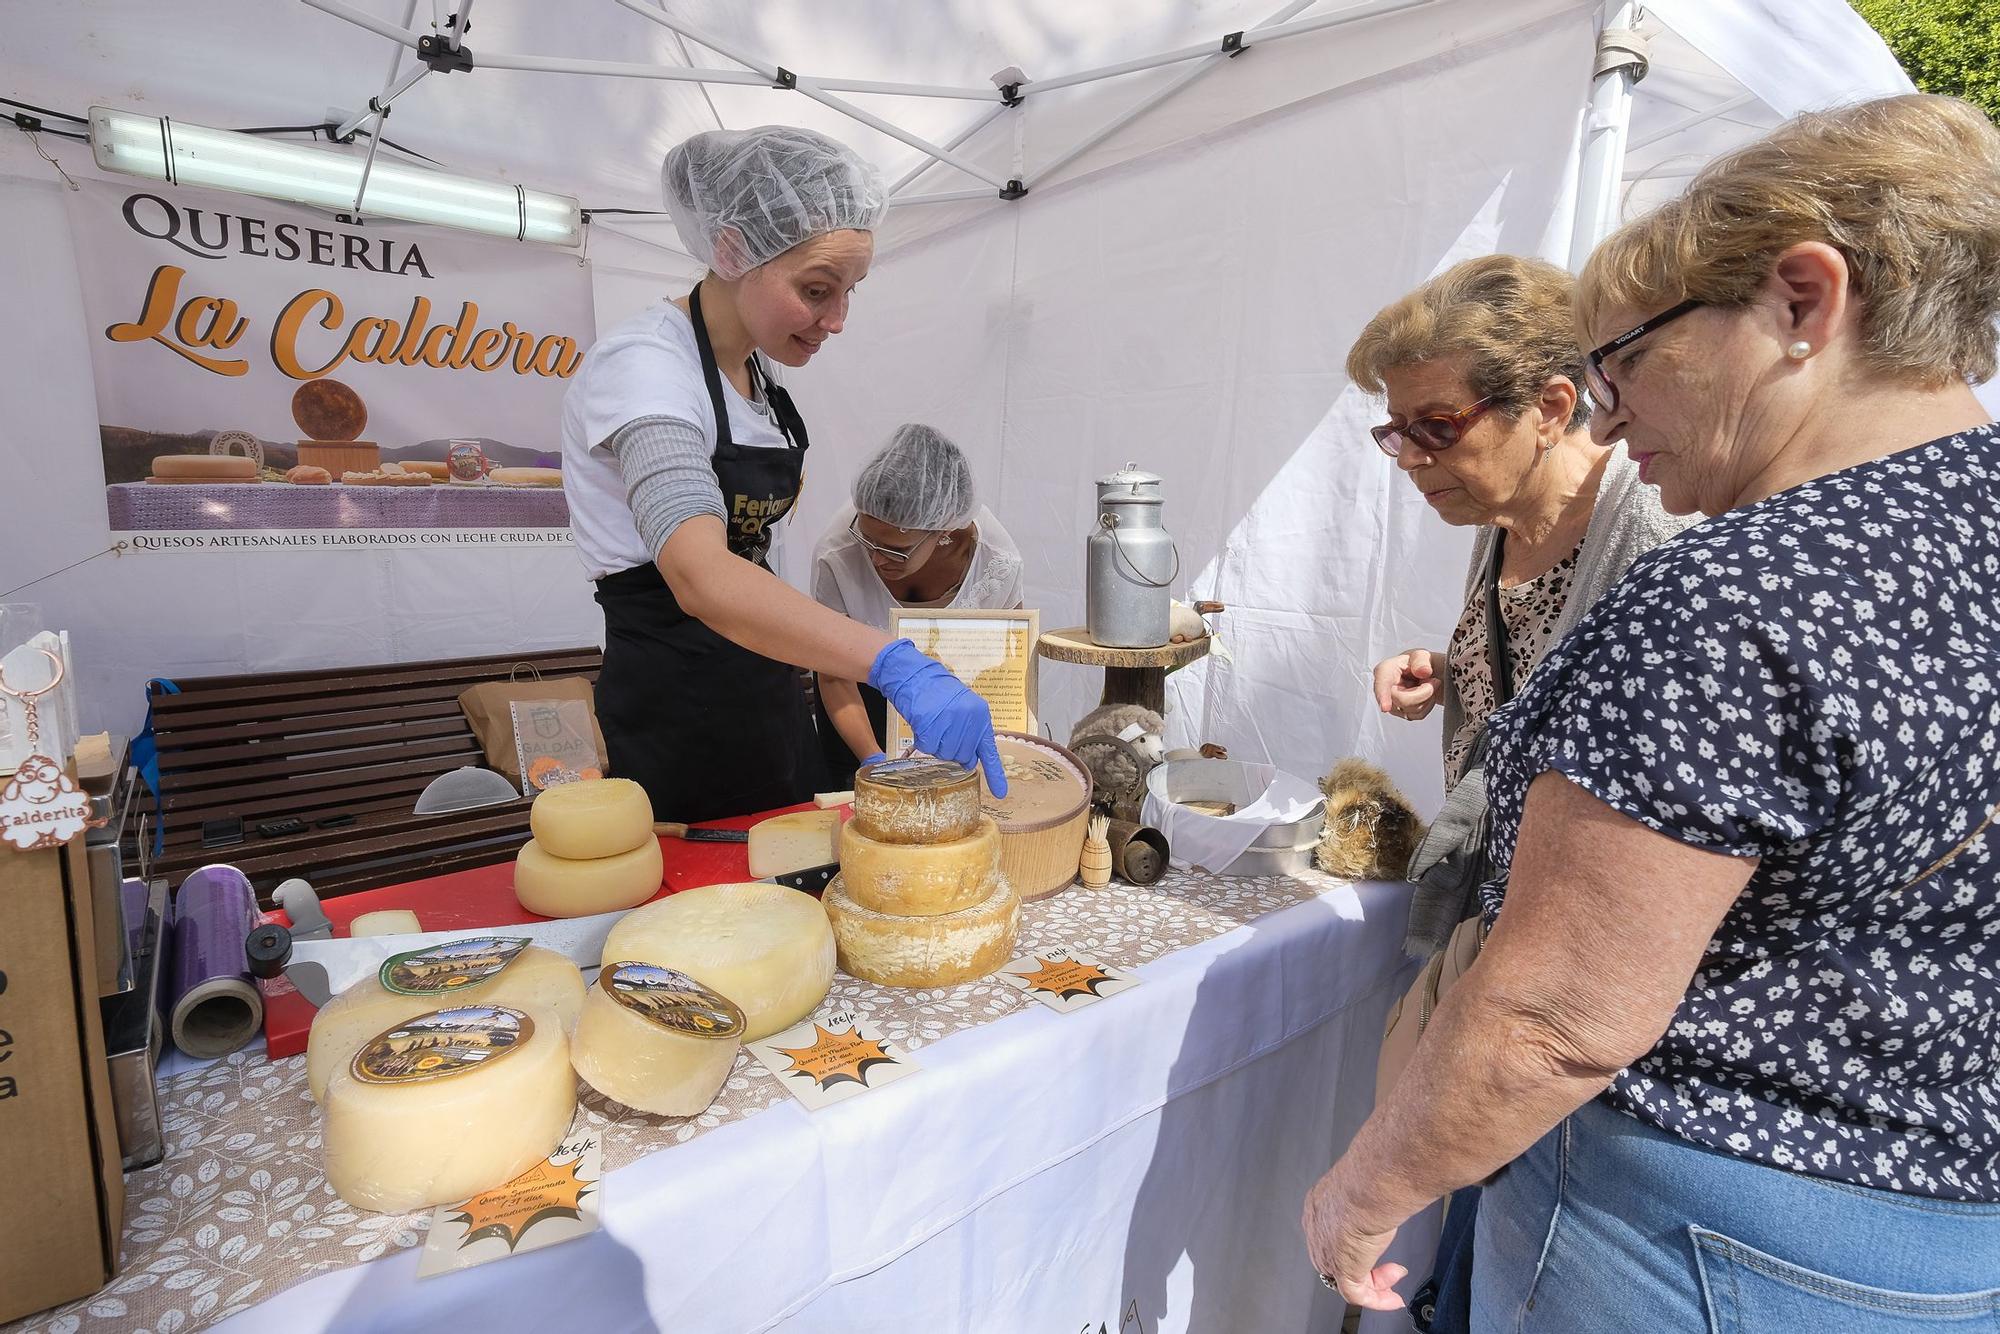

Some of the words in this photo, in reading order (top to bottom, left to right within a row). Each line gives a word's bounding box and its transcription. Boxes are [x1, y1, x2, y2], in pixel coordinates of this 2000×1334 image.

[122, 193, 435, 279] QUESERIA
[105, 265, 250, 376] La
[270, 288, 585, 380] Caldera
[1614, 326, 1646, 345] VOGART
[731, 515, 744, 525] del
[132, 535, 204, 551] QUESOS
[209, 534, 317, 547] ARTESANALES
[322, 533, 417, 545] ELABORADOS
[420, 532, 451, 544] CON
[456, 532, 497, 543] LECHE
[500, 532, 543, 543] CRUDA
[547, 532, 563, 542] DE
[1, 806, 87, 828] Calderita
